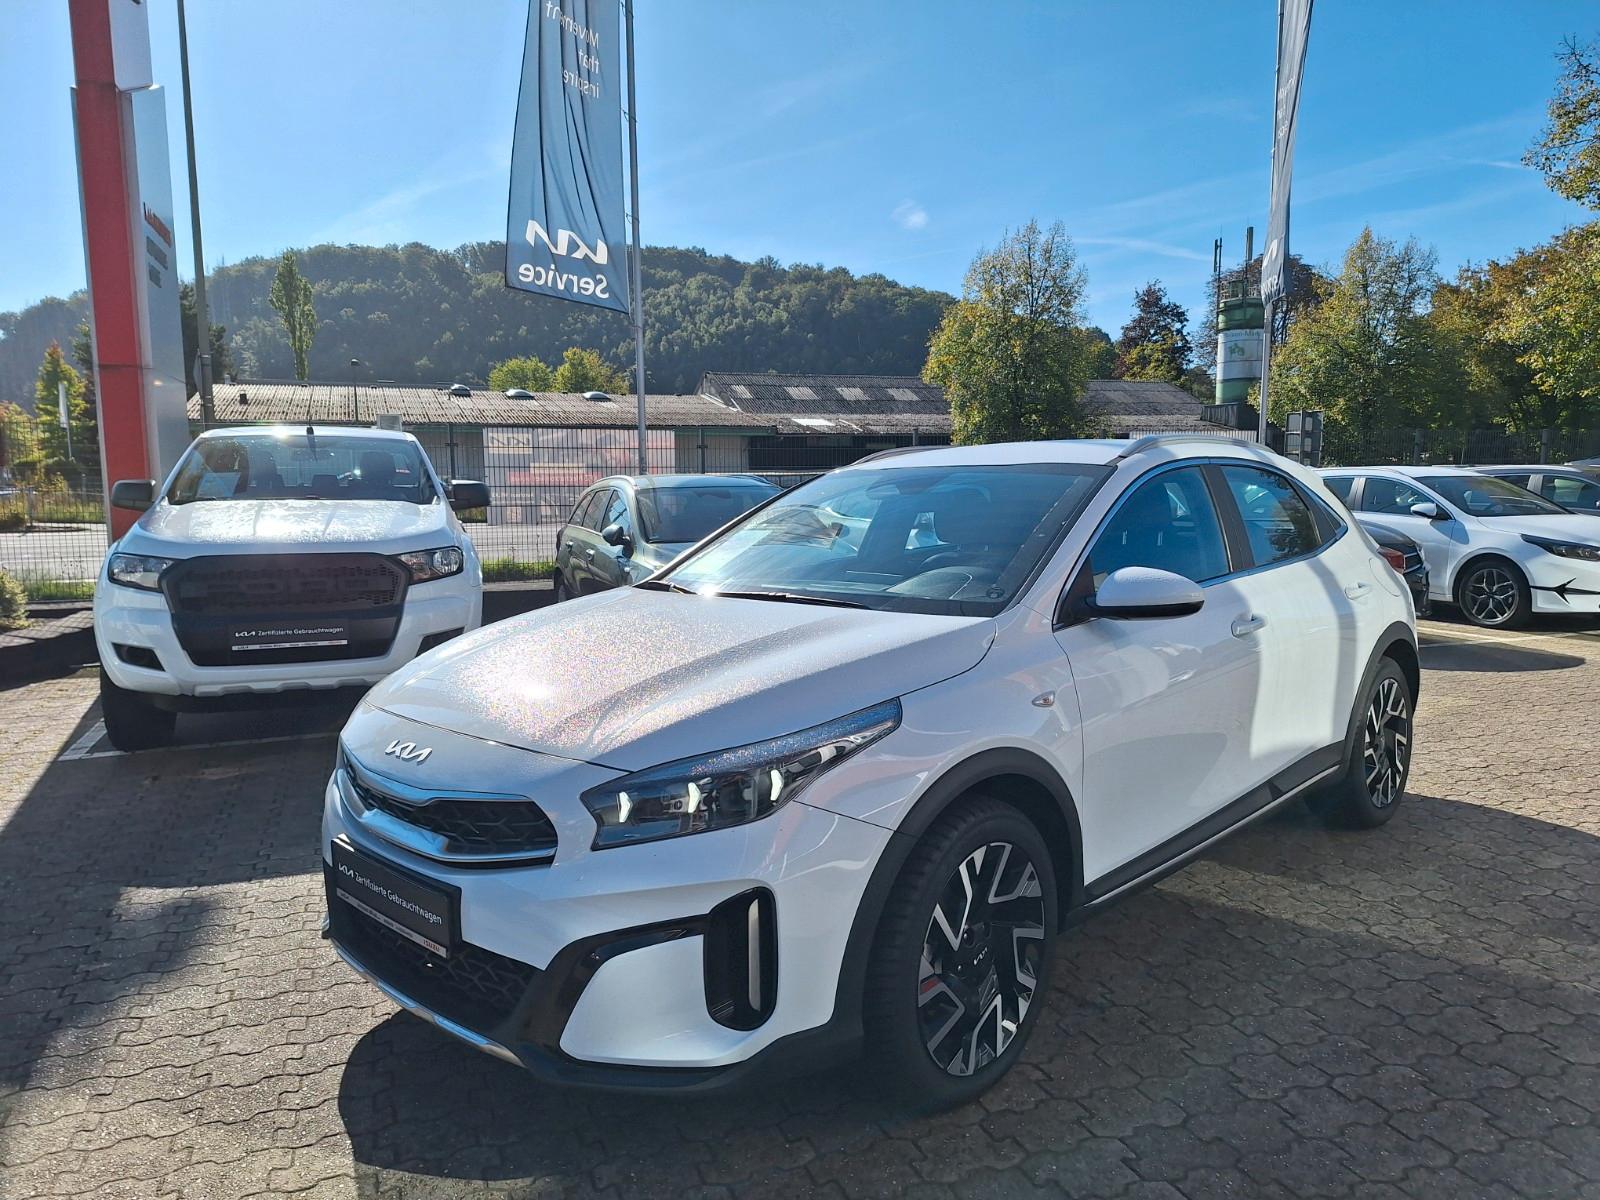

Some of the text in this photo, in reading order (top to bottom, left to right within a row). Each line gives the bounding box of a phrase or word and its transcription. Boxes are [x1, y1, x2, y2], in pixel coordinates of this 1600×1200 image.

[294, 626, 344, 635] Gebrauchtwagen
[384, 739, 433, 764] KIA
[388, 890, 442, 925] Gebrauchtwagen
